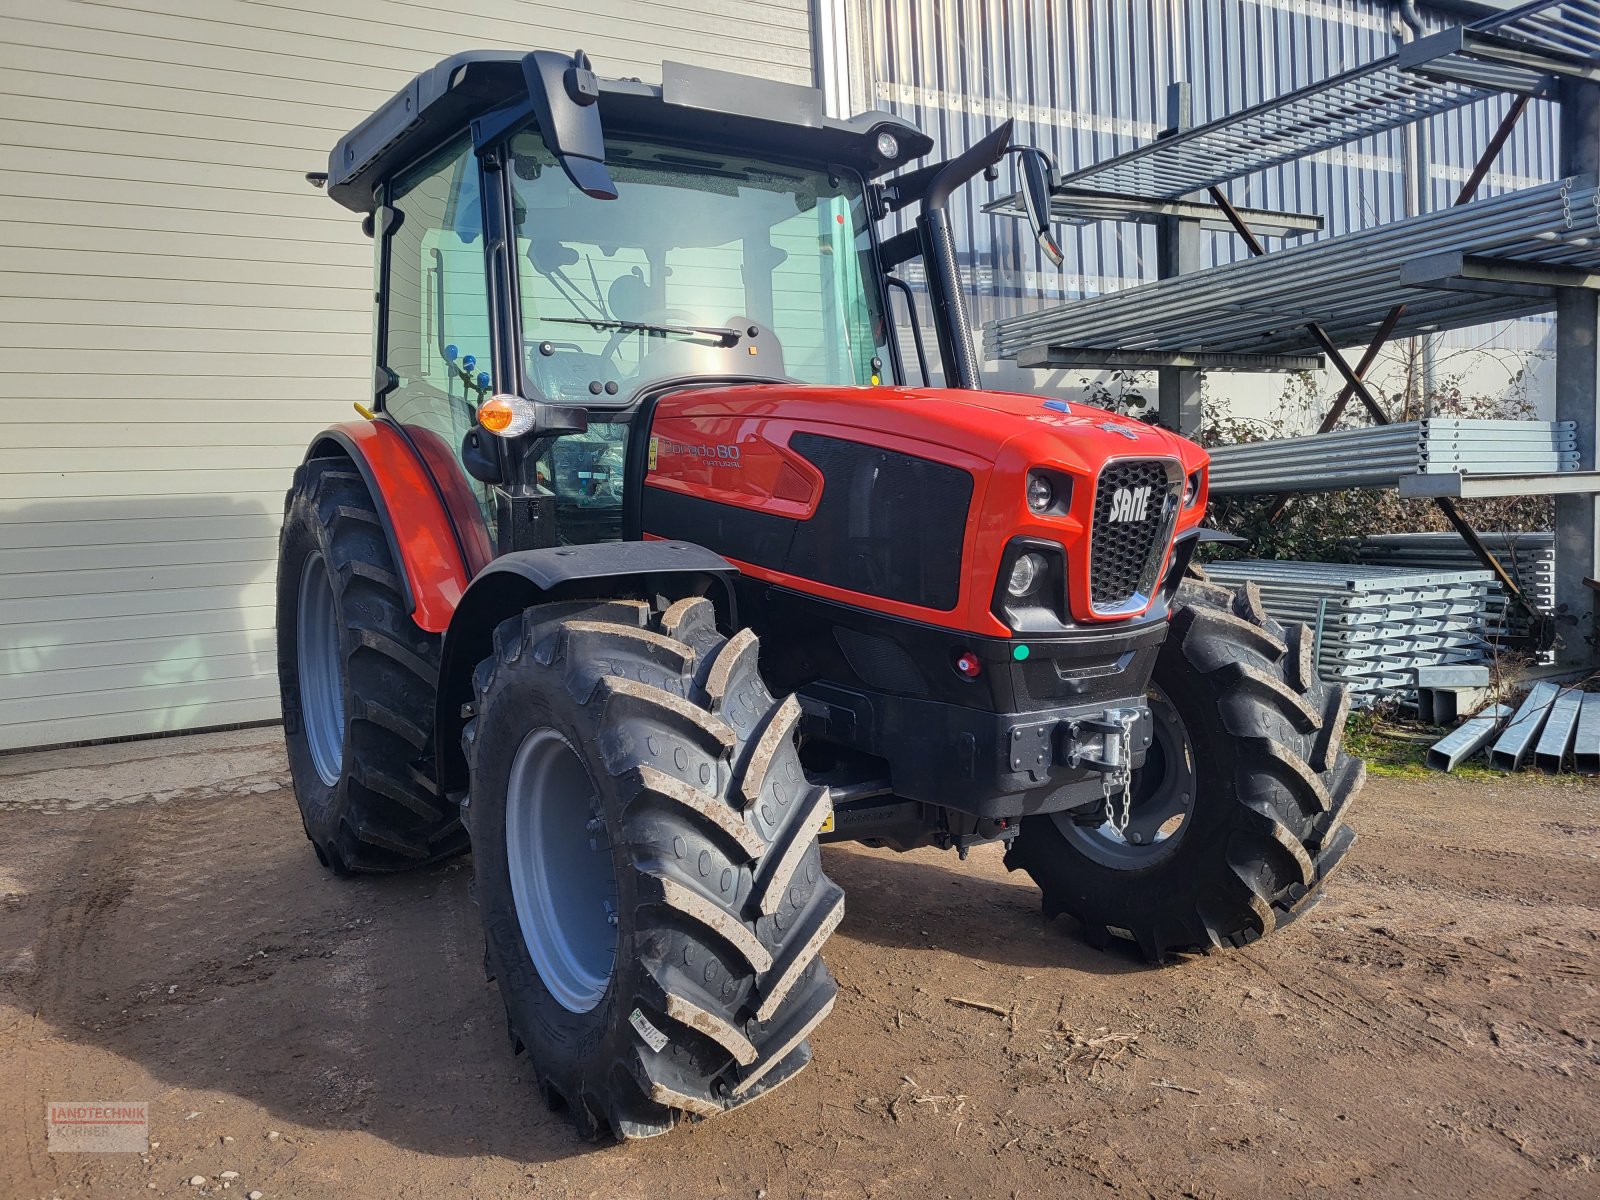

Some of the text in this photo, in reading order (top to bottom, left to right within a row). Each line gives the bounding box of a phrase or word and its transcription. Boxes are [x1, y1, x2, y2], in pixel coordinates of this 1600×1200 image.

[662, 439, 740, 459] Dorado 80
[702, 459, 743, 468] NATURAL
[1109, 486, 1152, 523] SAME
